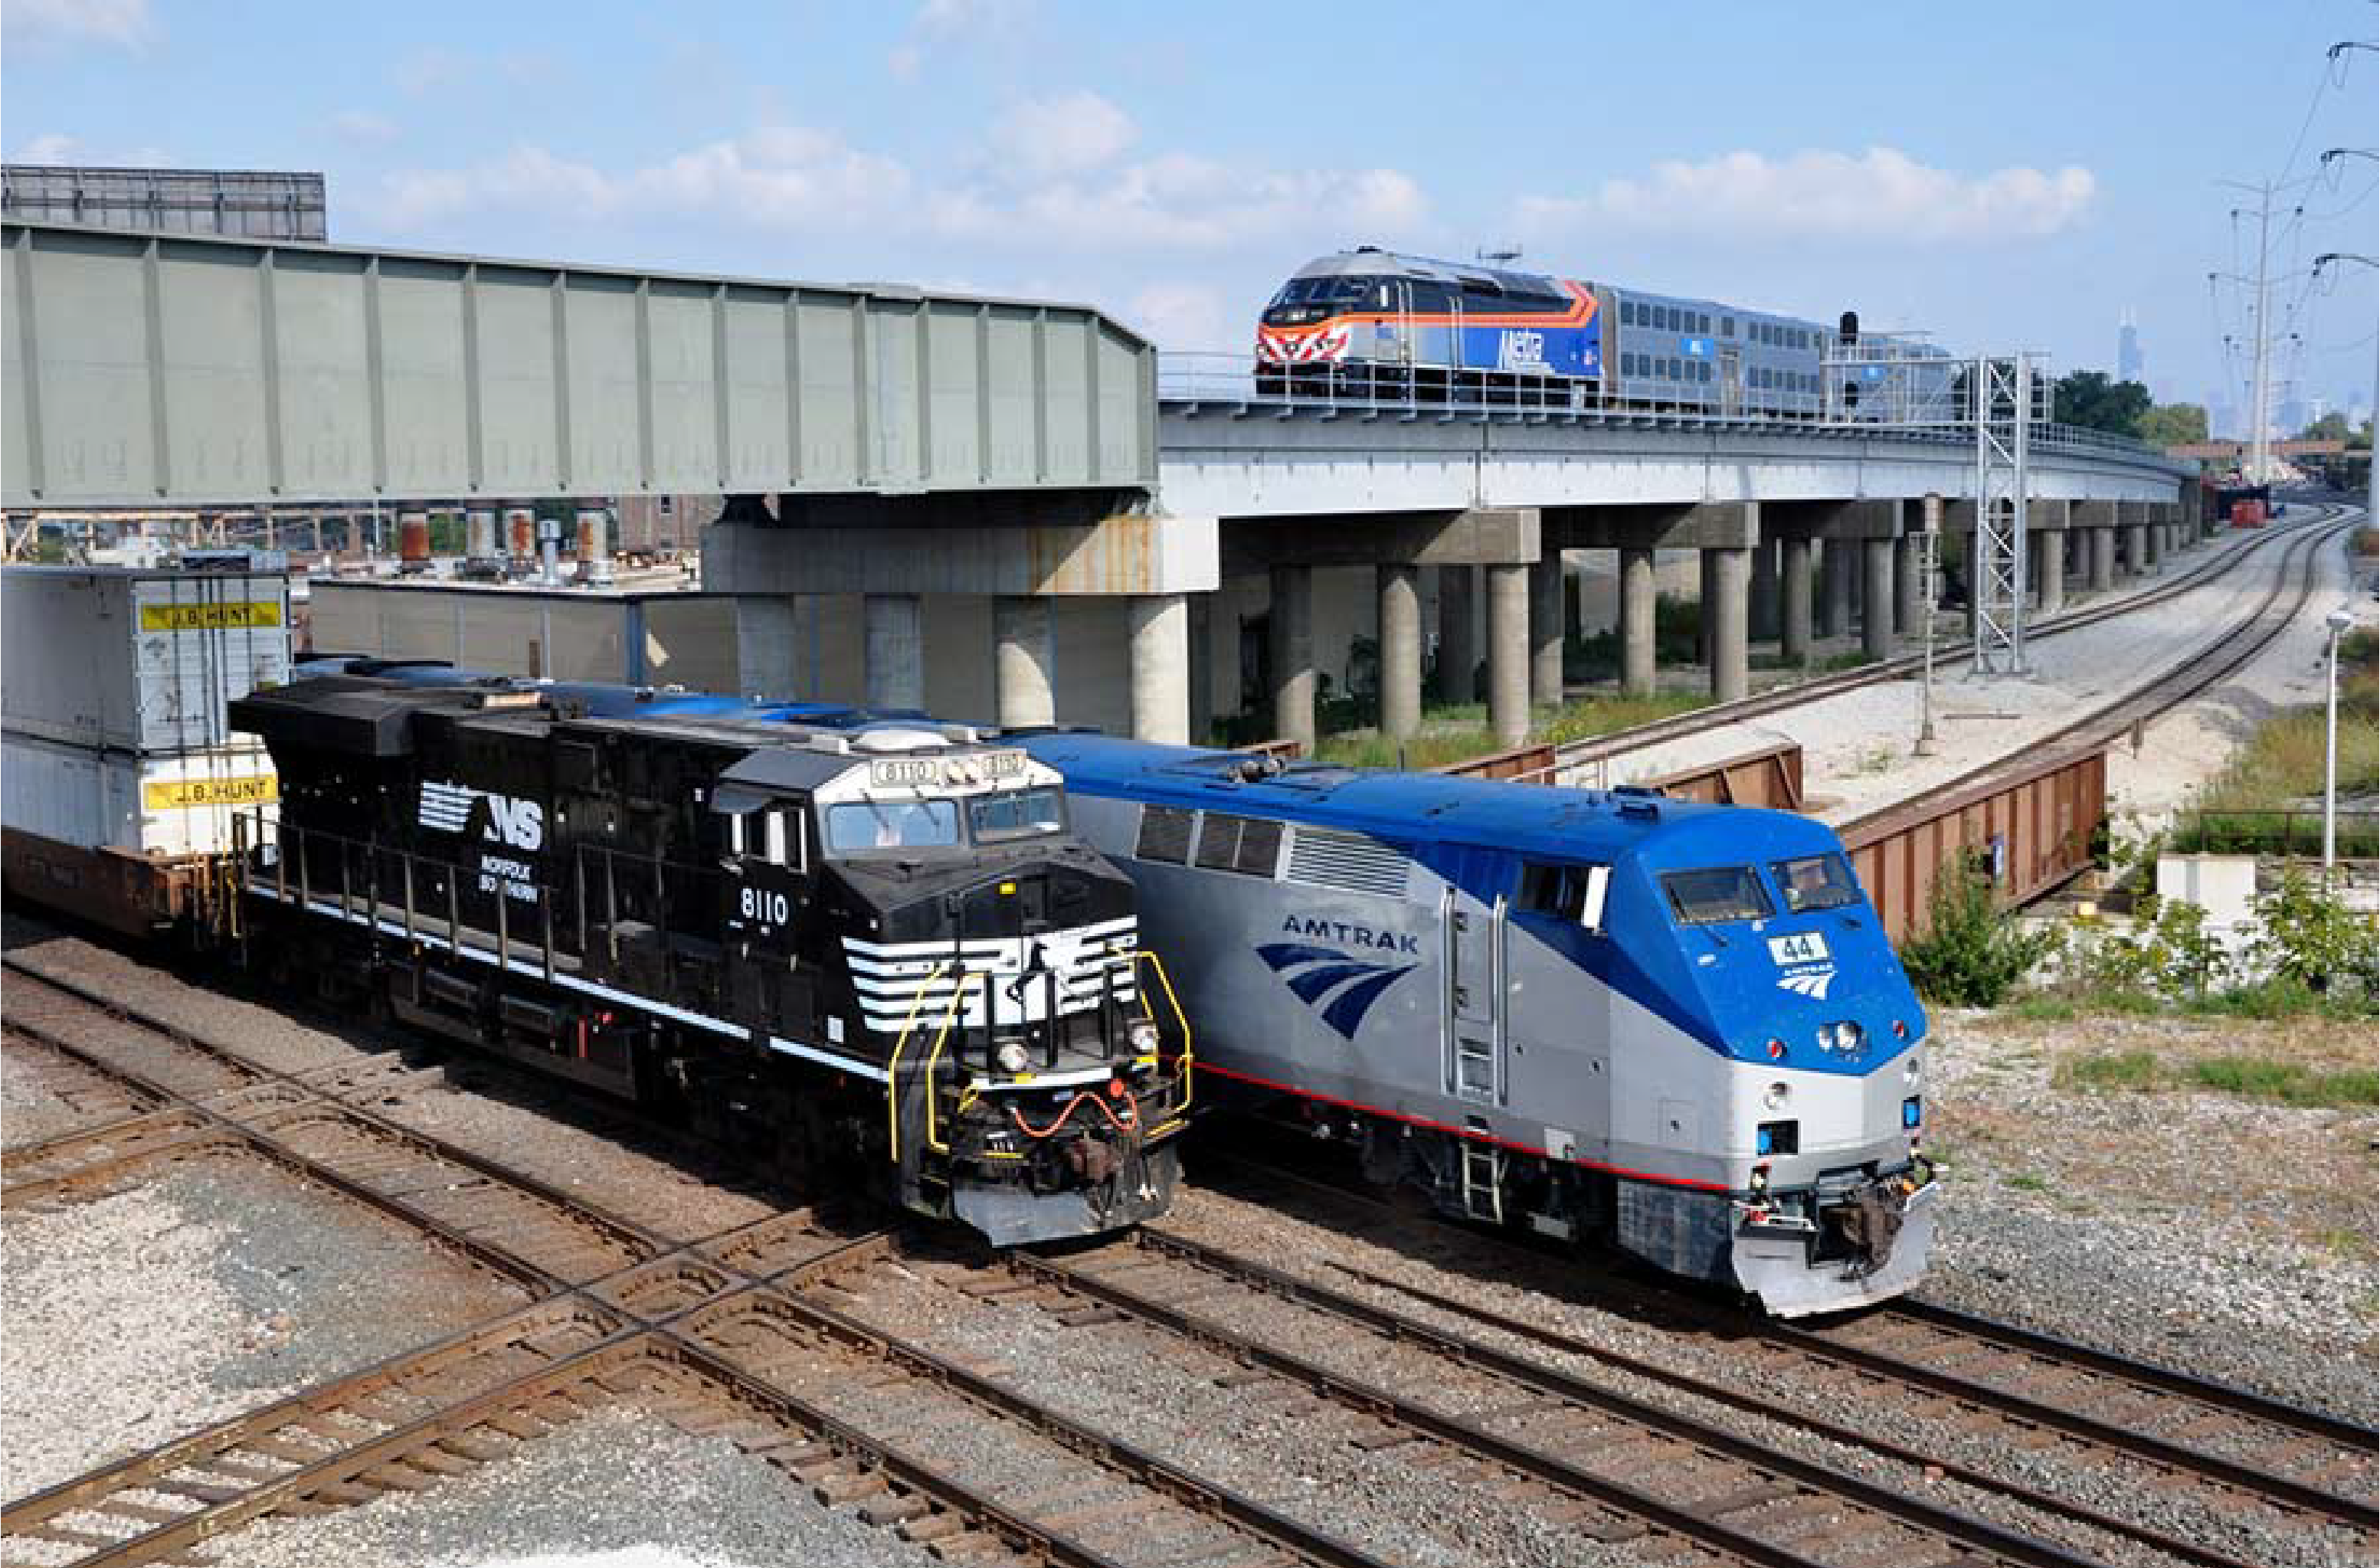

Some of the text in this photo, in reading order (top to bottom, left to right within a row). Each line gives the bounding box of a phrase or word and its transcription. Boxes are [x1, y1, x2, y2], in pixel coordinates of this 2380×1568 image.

[205, 607, 251, 624] HUNT
[214, 781, 266, 800] HUNT
[741, 886, 788, 925] 8110
[1282, 914, 1418, 954] AMTRAK
[1783, 936, 1815, 960] 44
